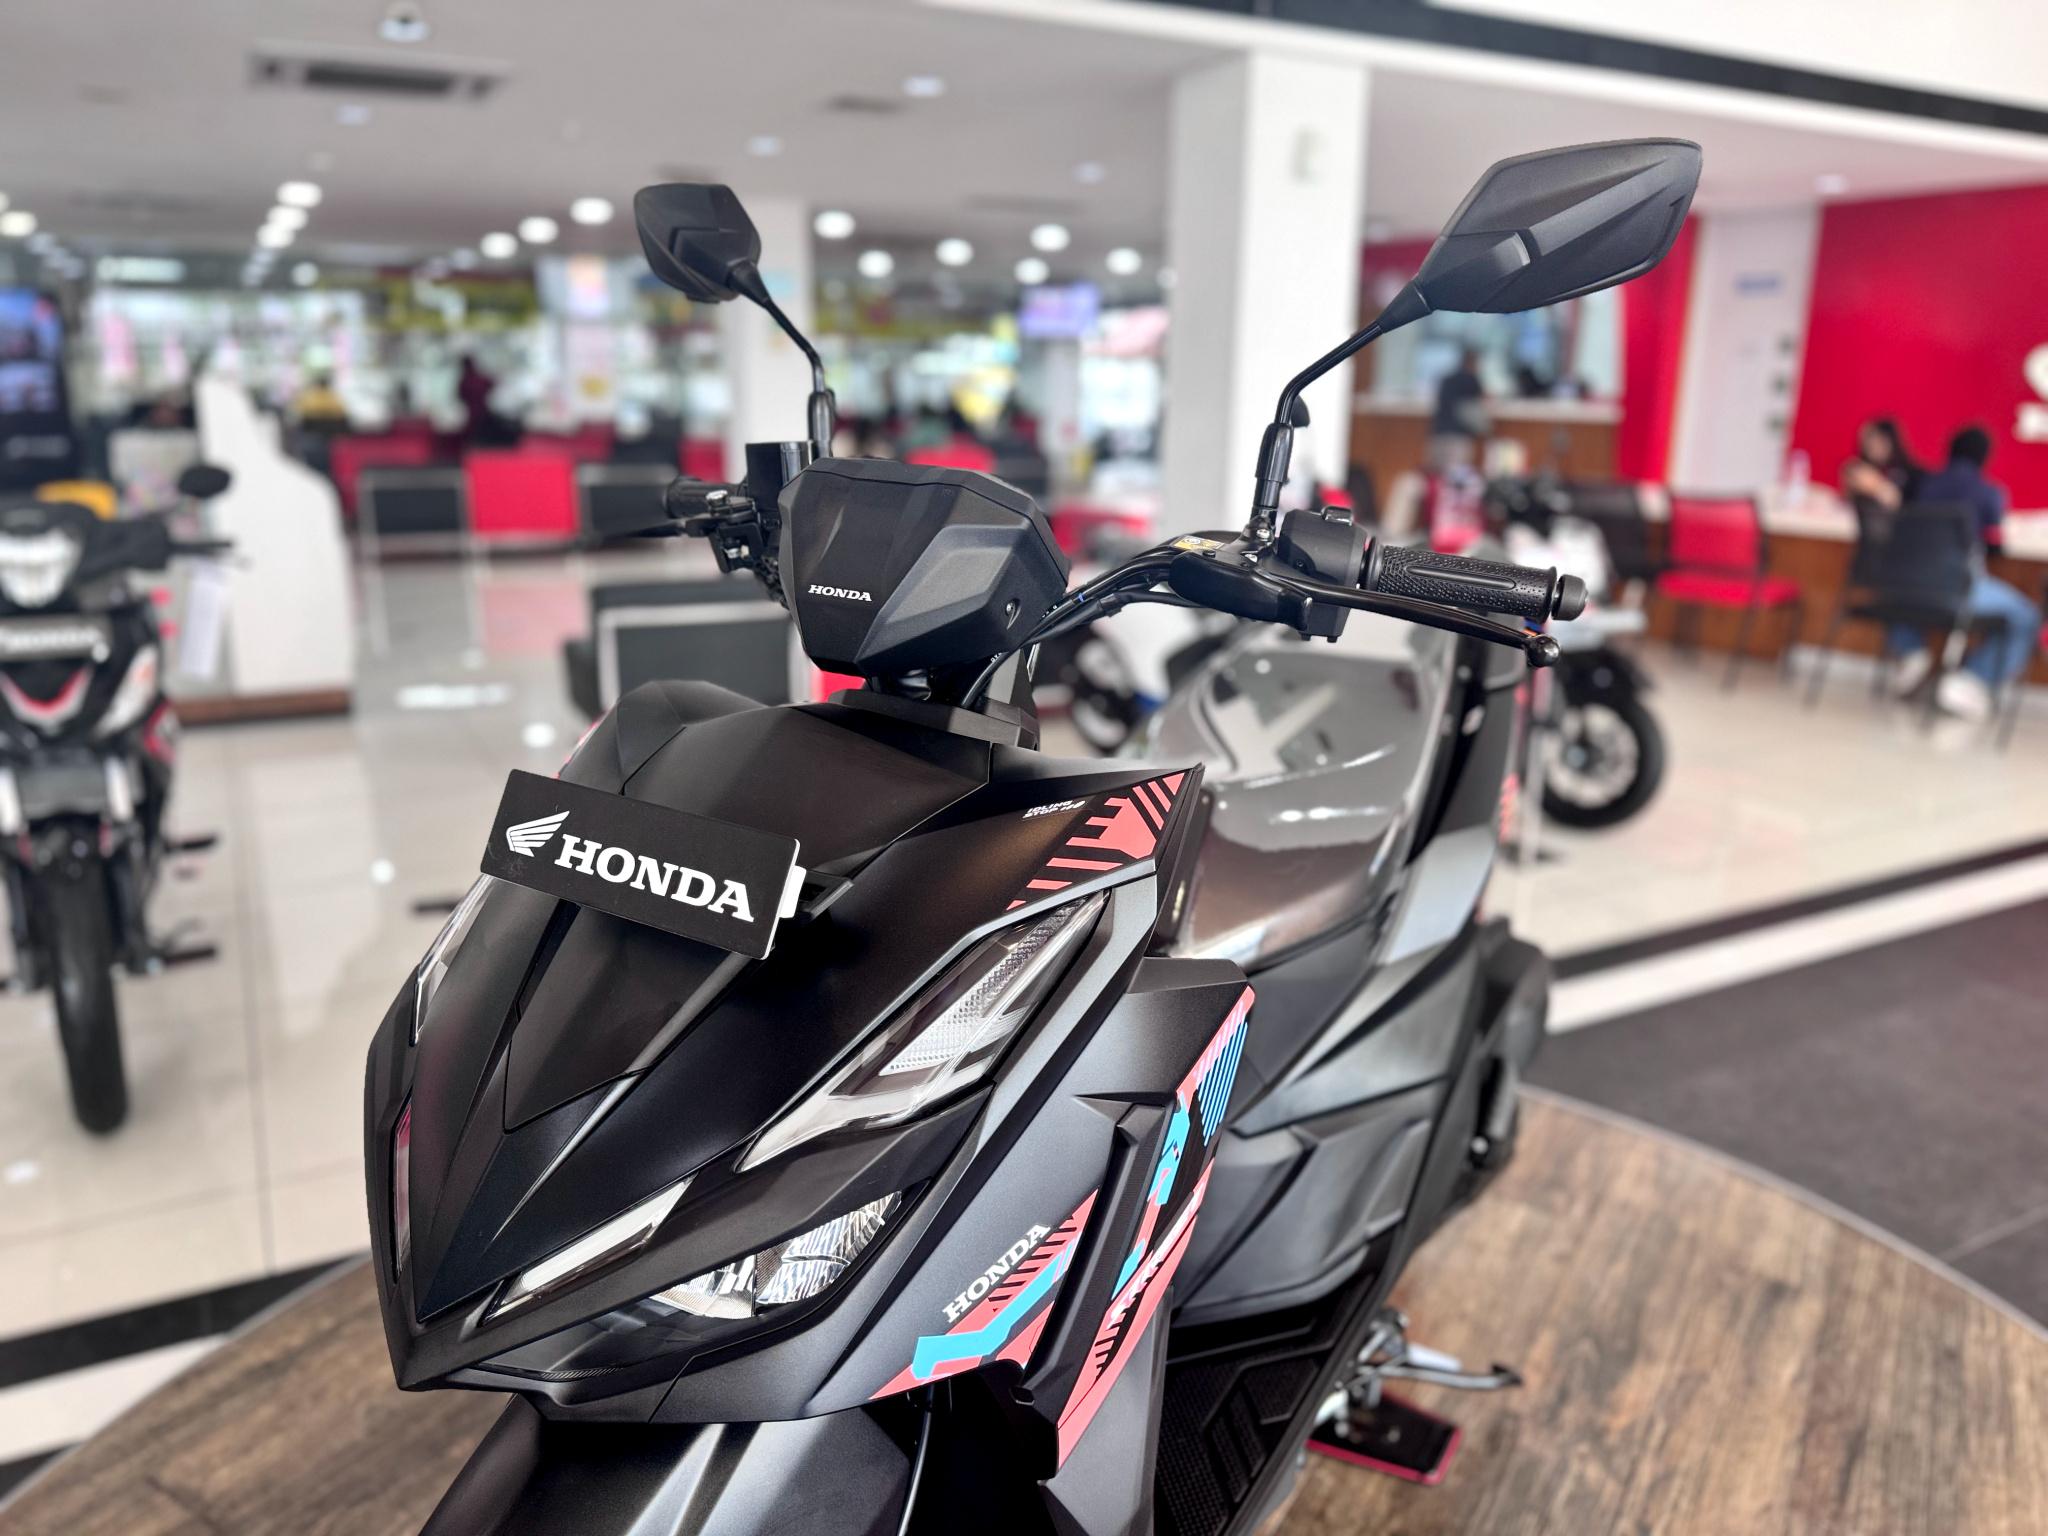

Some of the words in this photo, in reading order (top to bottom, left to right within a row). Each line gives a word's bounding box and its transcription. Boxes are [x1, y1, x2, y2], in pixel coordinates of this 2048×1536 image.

[807, 584, 873, 602] HONDA
[554, 833, 754, 922] HONDA
[942, 1224, 1051, 1323] HONDA
